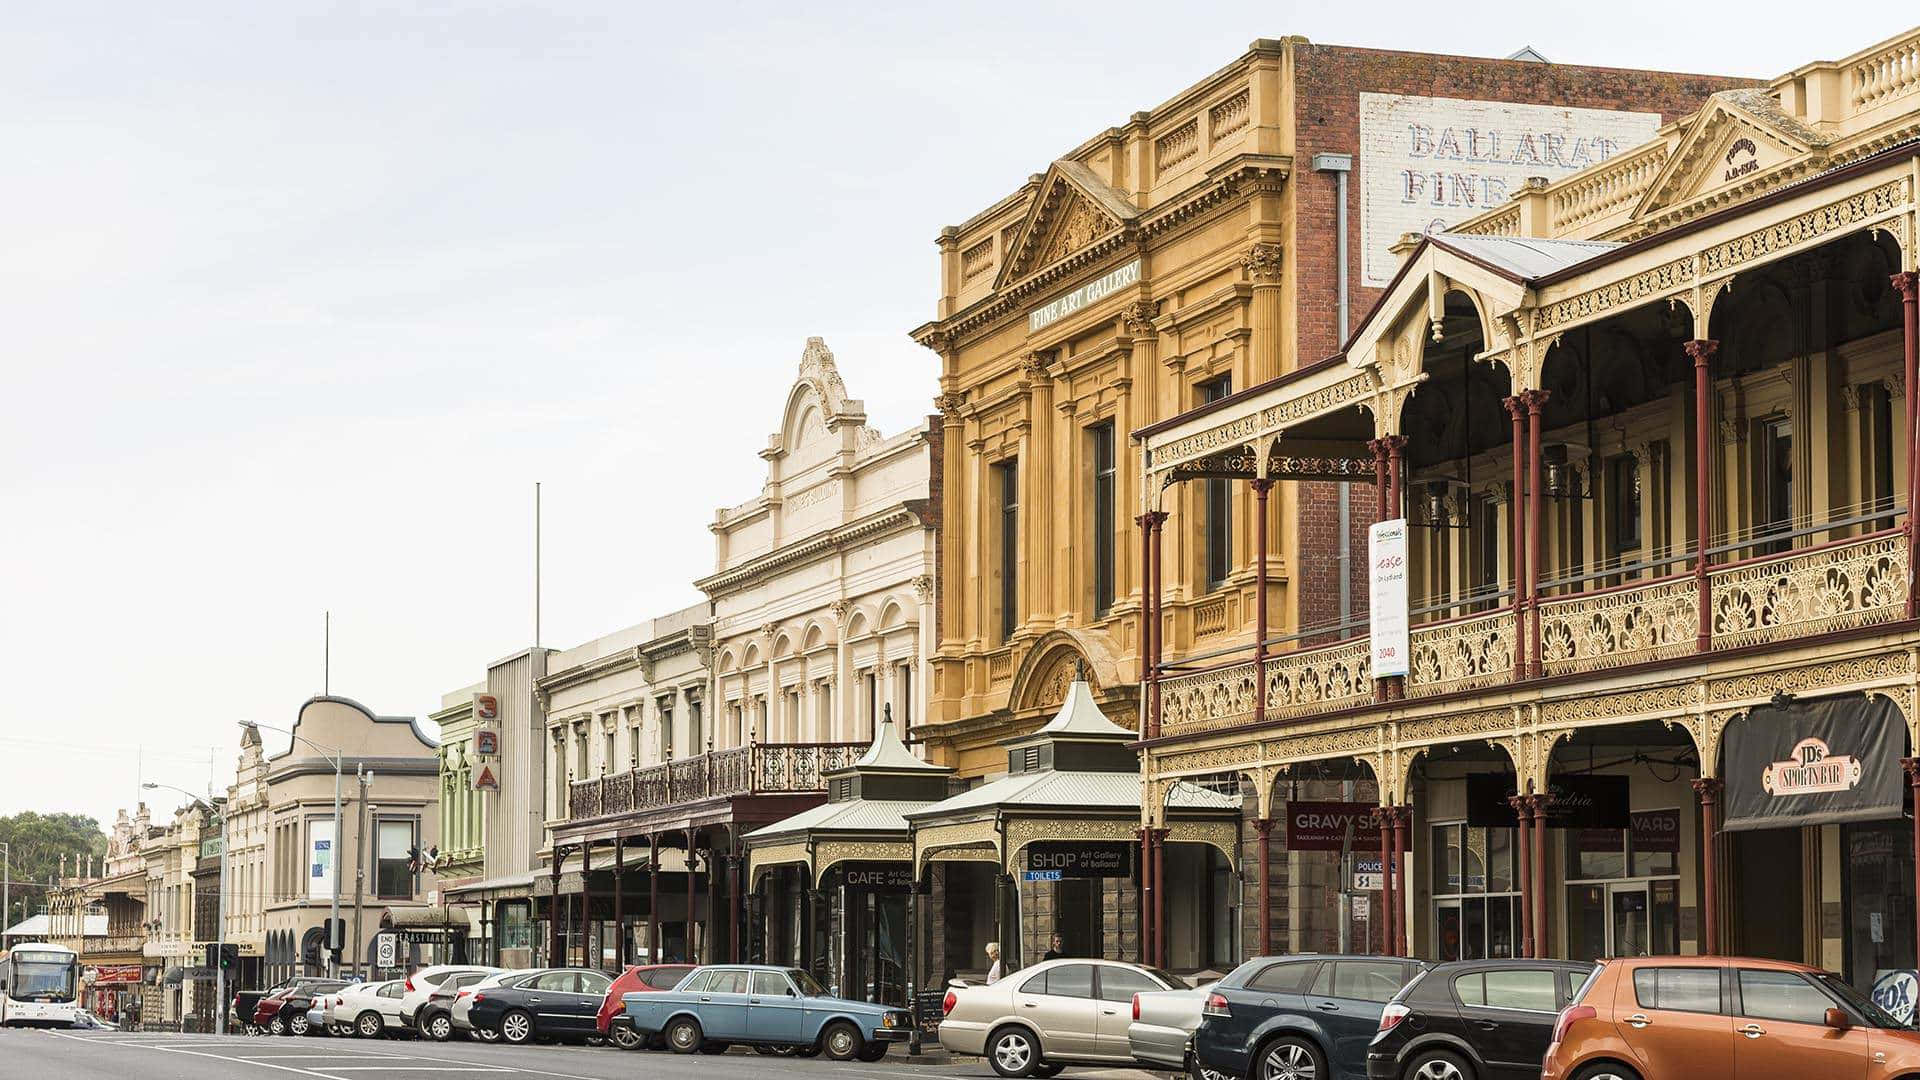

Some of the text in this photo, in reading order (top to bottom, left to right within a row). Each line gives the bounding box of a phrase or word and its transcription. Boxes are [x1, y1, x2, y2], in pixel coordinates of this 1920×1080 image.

[1033, 258, 1138, 329] FINE ART GALLERY
[1800, 744, 1822, 768] JD's
[1783, 764, 1840, 787] SPORTS BAR
[1296, 814, 1351, 829] GRAVY
[1033, 853, 1076, 868] SHOP
[1094, 851, 1121, 861] Gallery
[1358, 862, 1384, 871] POLICE
[848, 872, 884, 884] CAFE
[1030, 872, 1060, 880] TOILETS
[1874, 977, 1911, 1010] FOX
